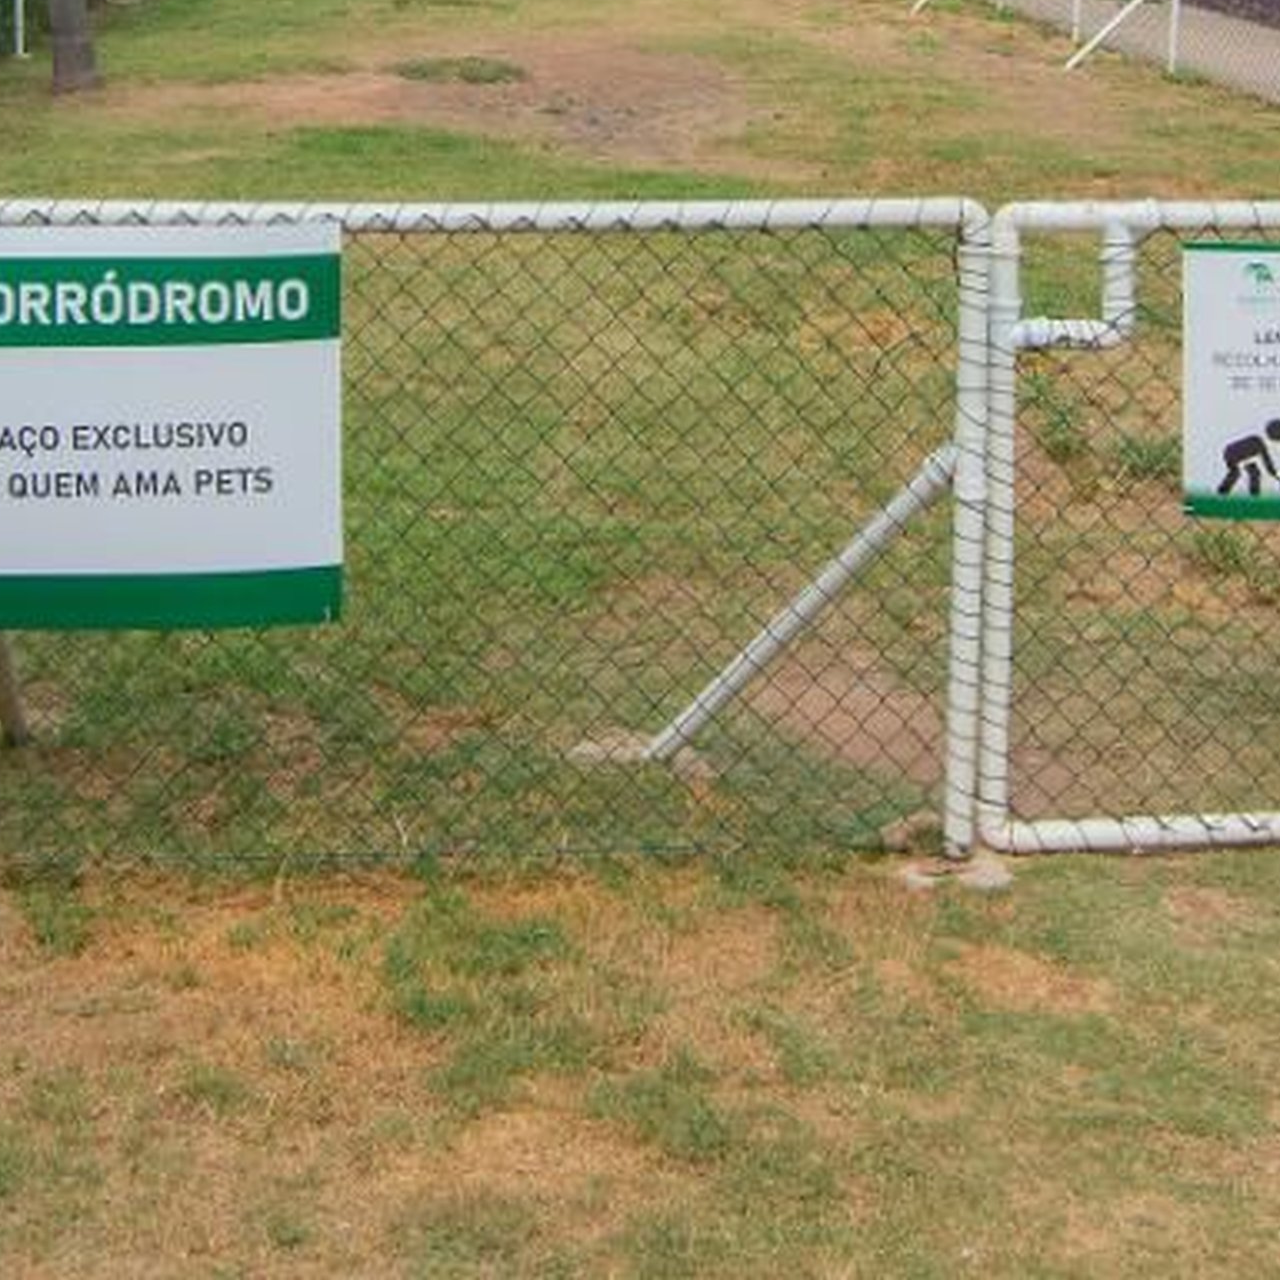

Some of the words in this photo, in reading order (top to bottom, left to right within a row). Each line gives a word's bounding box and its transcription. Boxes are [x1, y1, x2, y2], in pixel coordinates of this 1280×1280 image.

[72, 421, 249, 451] EXCLUSIVO
[8, 472, 100, 498] QUEM
[112, 470, 182, 497] AMA
[194, 468, 274, 495] PETS
